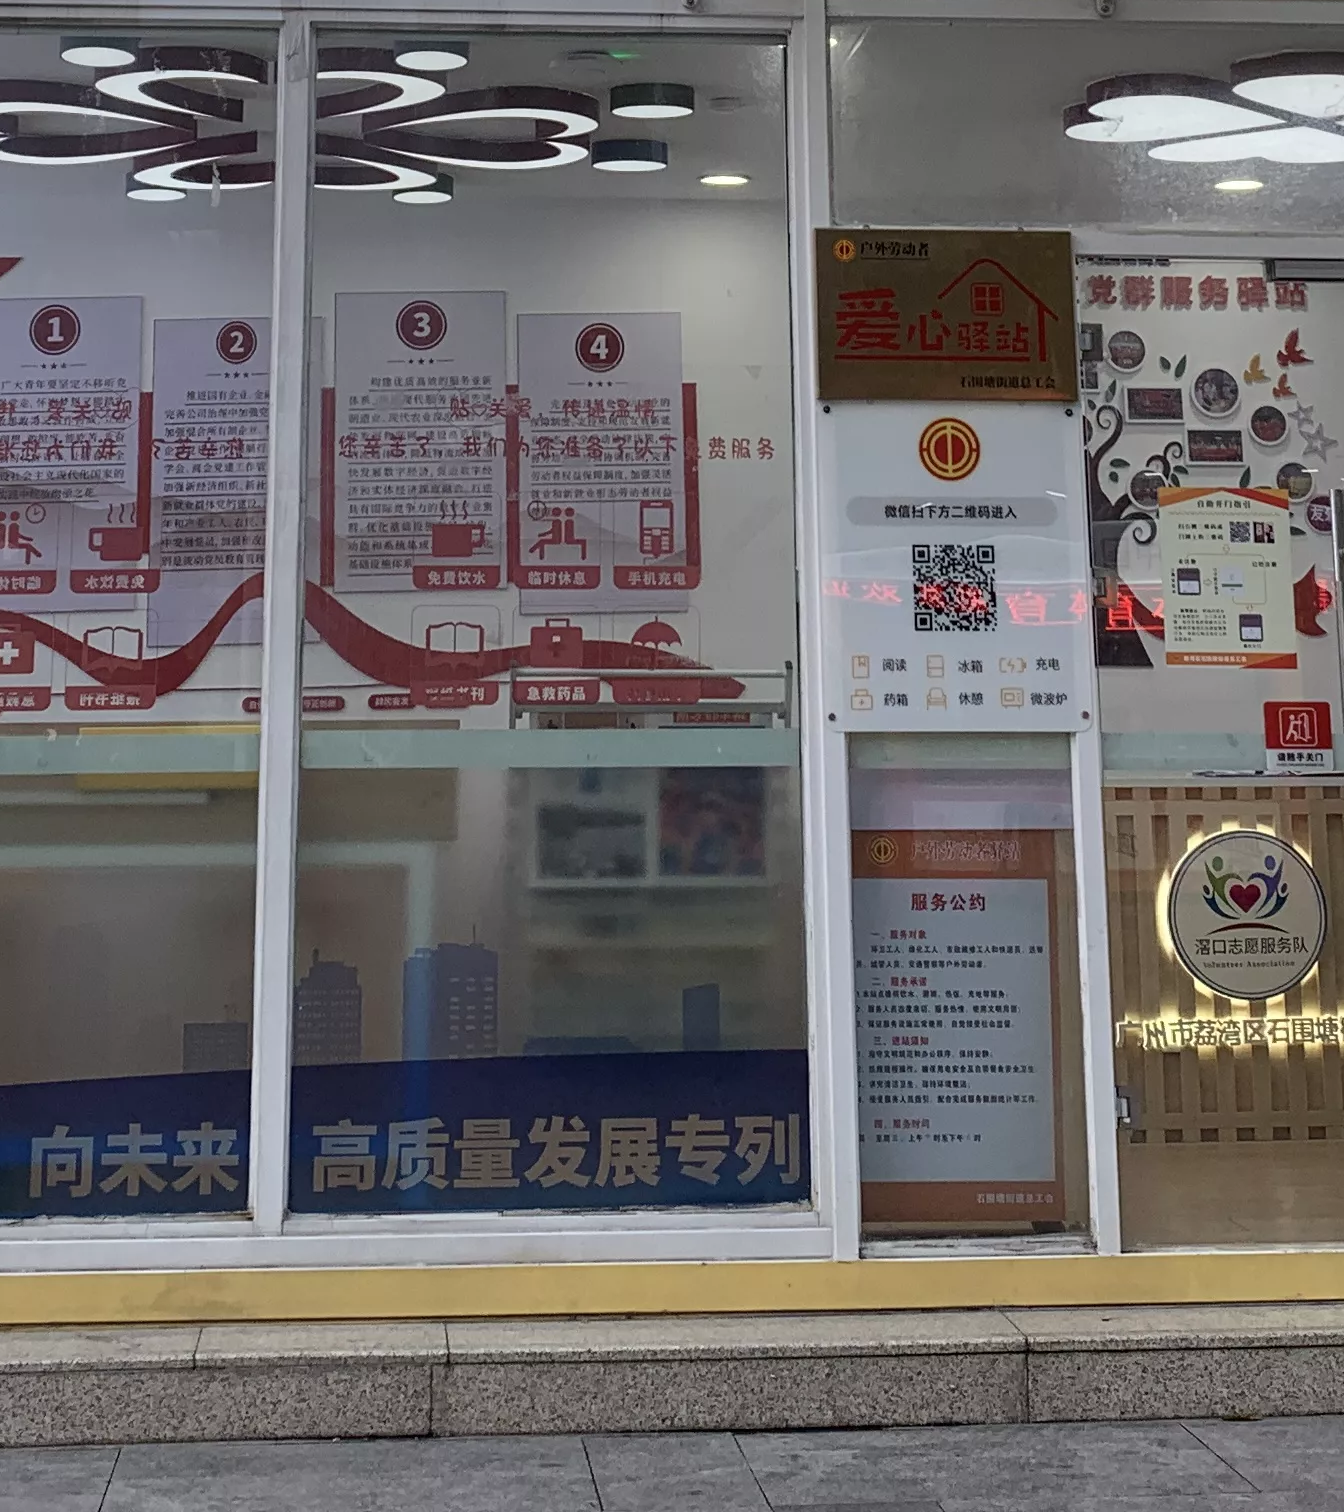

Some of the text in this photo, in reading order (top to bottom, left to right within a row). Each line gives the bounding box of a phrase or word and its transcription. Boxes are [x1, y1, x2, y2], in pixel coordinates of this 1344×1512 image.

[860, 241, 930, 257] 户外劳动者
[1087, 275, 1306, 306] 党群服务驿站
[414, 313, 431, 338] 3
[835, 288, 1030, 351] 爱心驿站
[47, 317, 64, 343] 1
[230, 331, 245, 353] 2
[589, 334, 609, 359] 4
[960, 375, 1057, 389] 石围塘街道总工会
[884, 504, 1017, 519] 微信扫下方二维码进入
[427, 569, 687, 586] 免费饮水 临时休息 手机充电
[882, 657, 1060, 674] 阅读 冰箱 充电
[527, 686, 586, 701] 急救药品
[883, 692, 1068, 707] 药箱 休憩 微波炉
[910, 893, 987, 913] 服务公约
[1195, 936, 1309, 956] 滘口志愿服务队
[28, 1112, 802, 1198] 向未来 高质量发展专列
